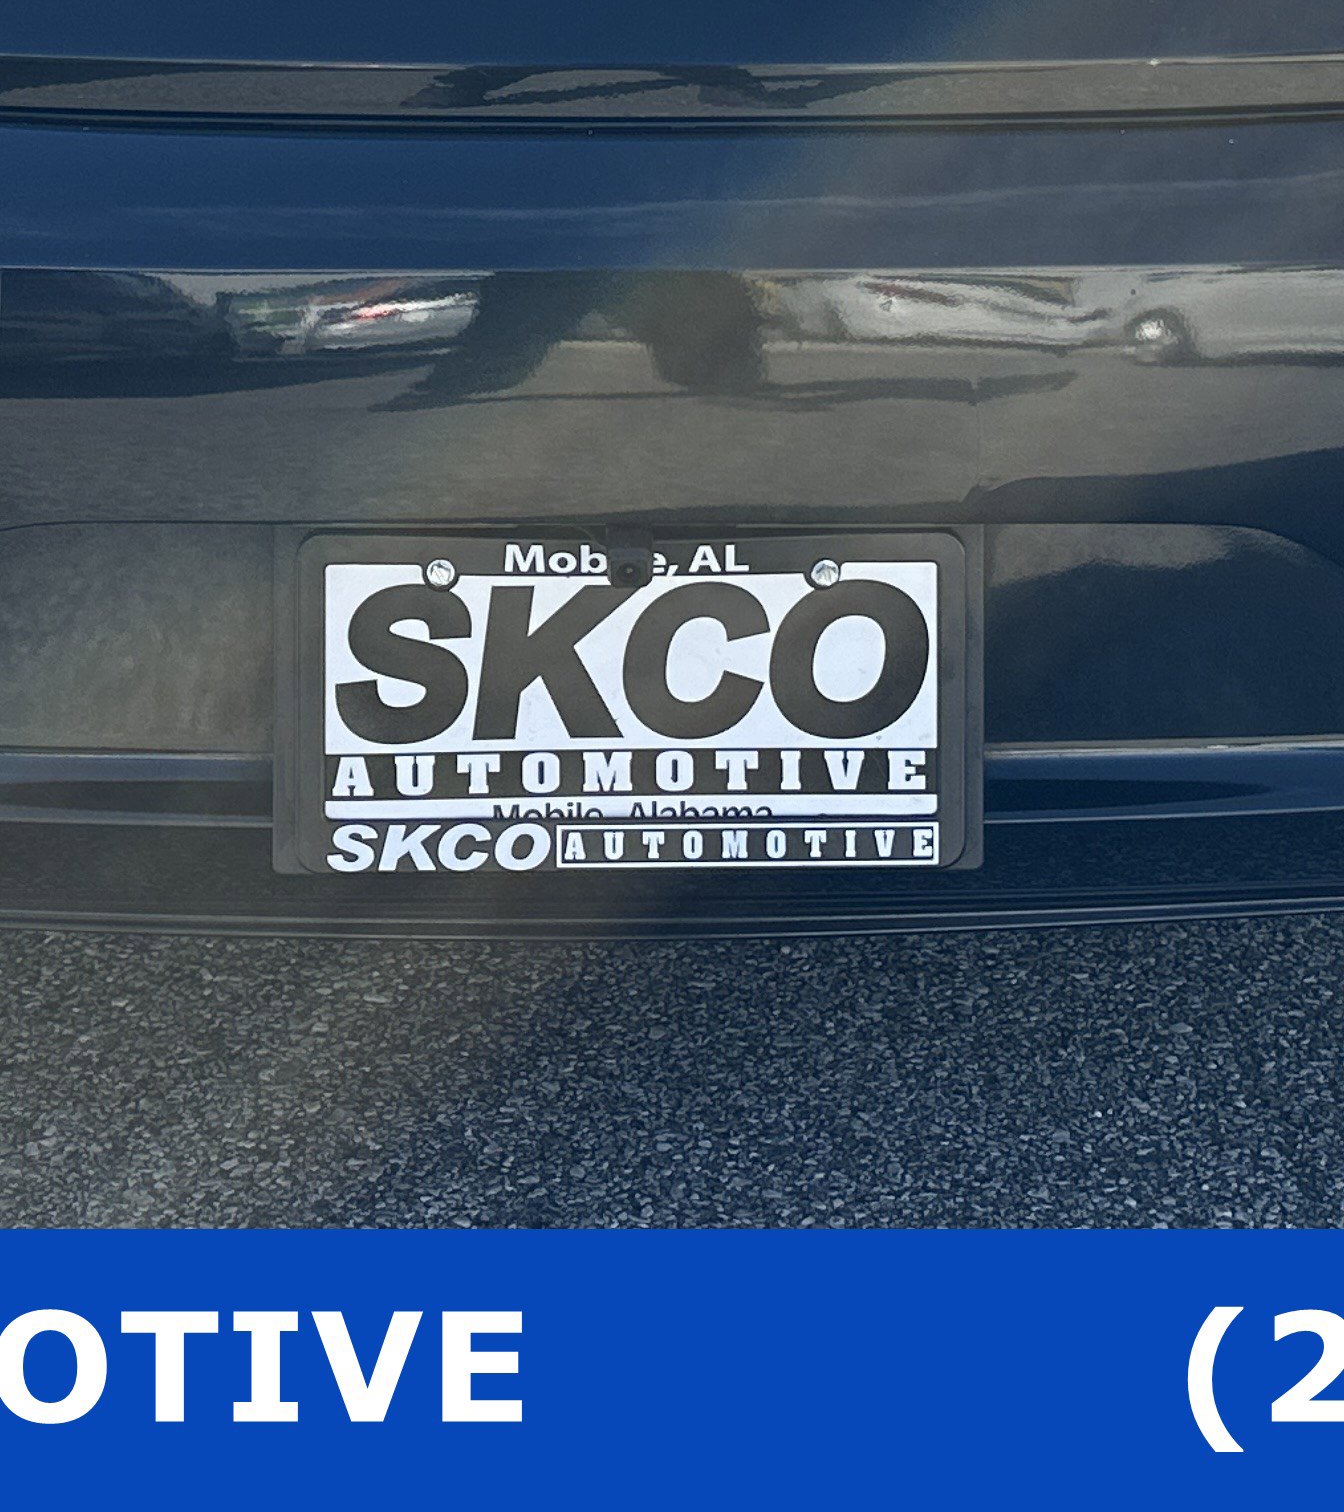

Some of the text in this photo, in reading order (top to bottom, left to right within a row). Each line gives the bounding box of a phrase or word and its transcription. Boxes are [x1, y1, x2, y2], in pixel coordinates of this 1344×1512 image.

[504, 544, 750, 579] Mobe, AL
[334, 579, 930, 745] SKCO
[332, 750, 927, 797] AUTOMOTIVE
[327, 823, 934, 872] SKCO AUTOMOTIVE
